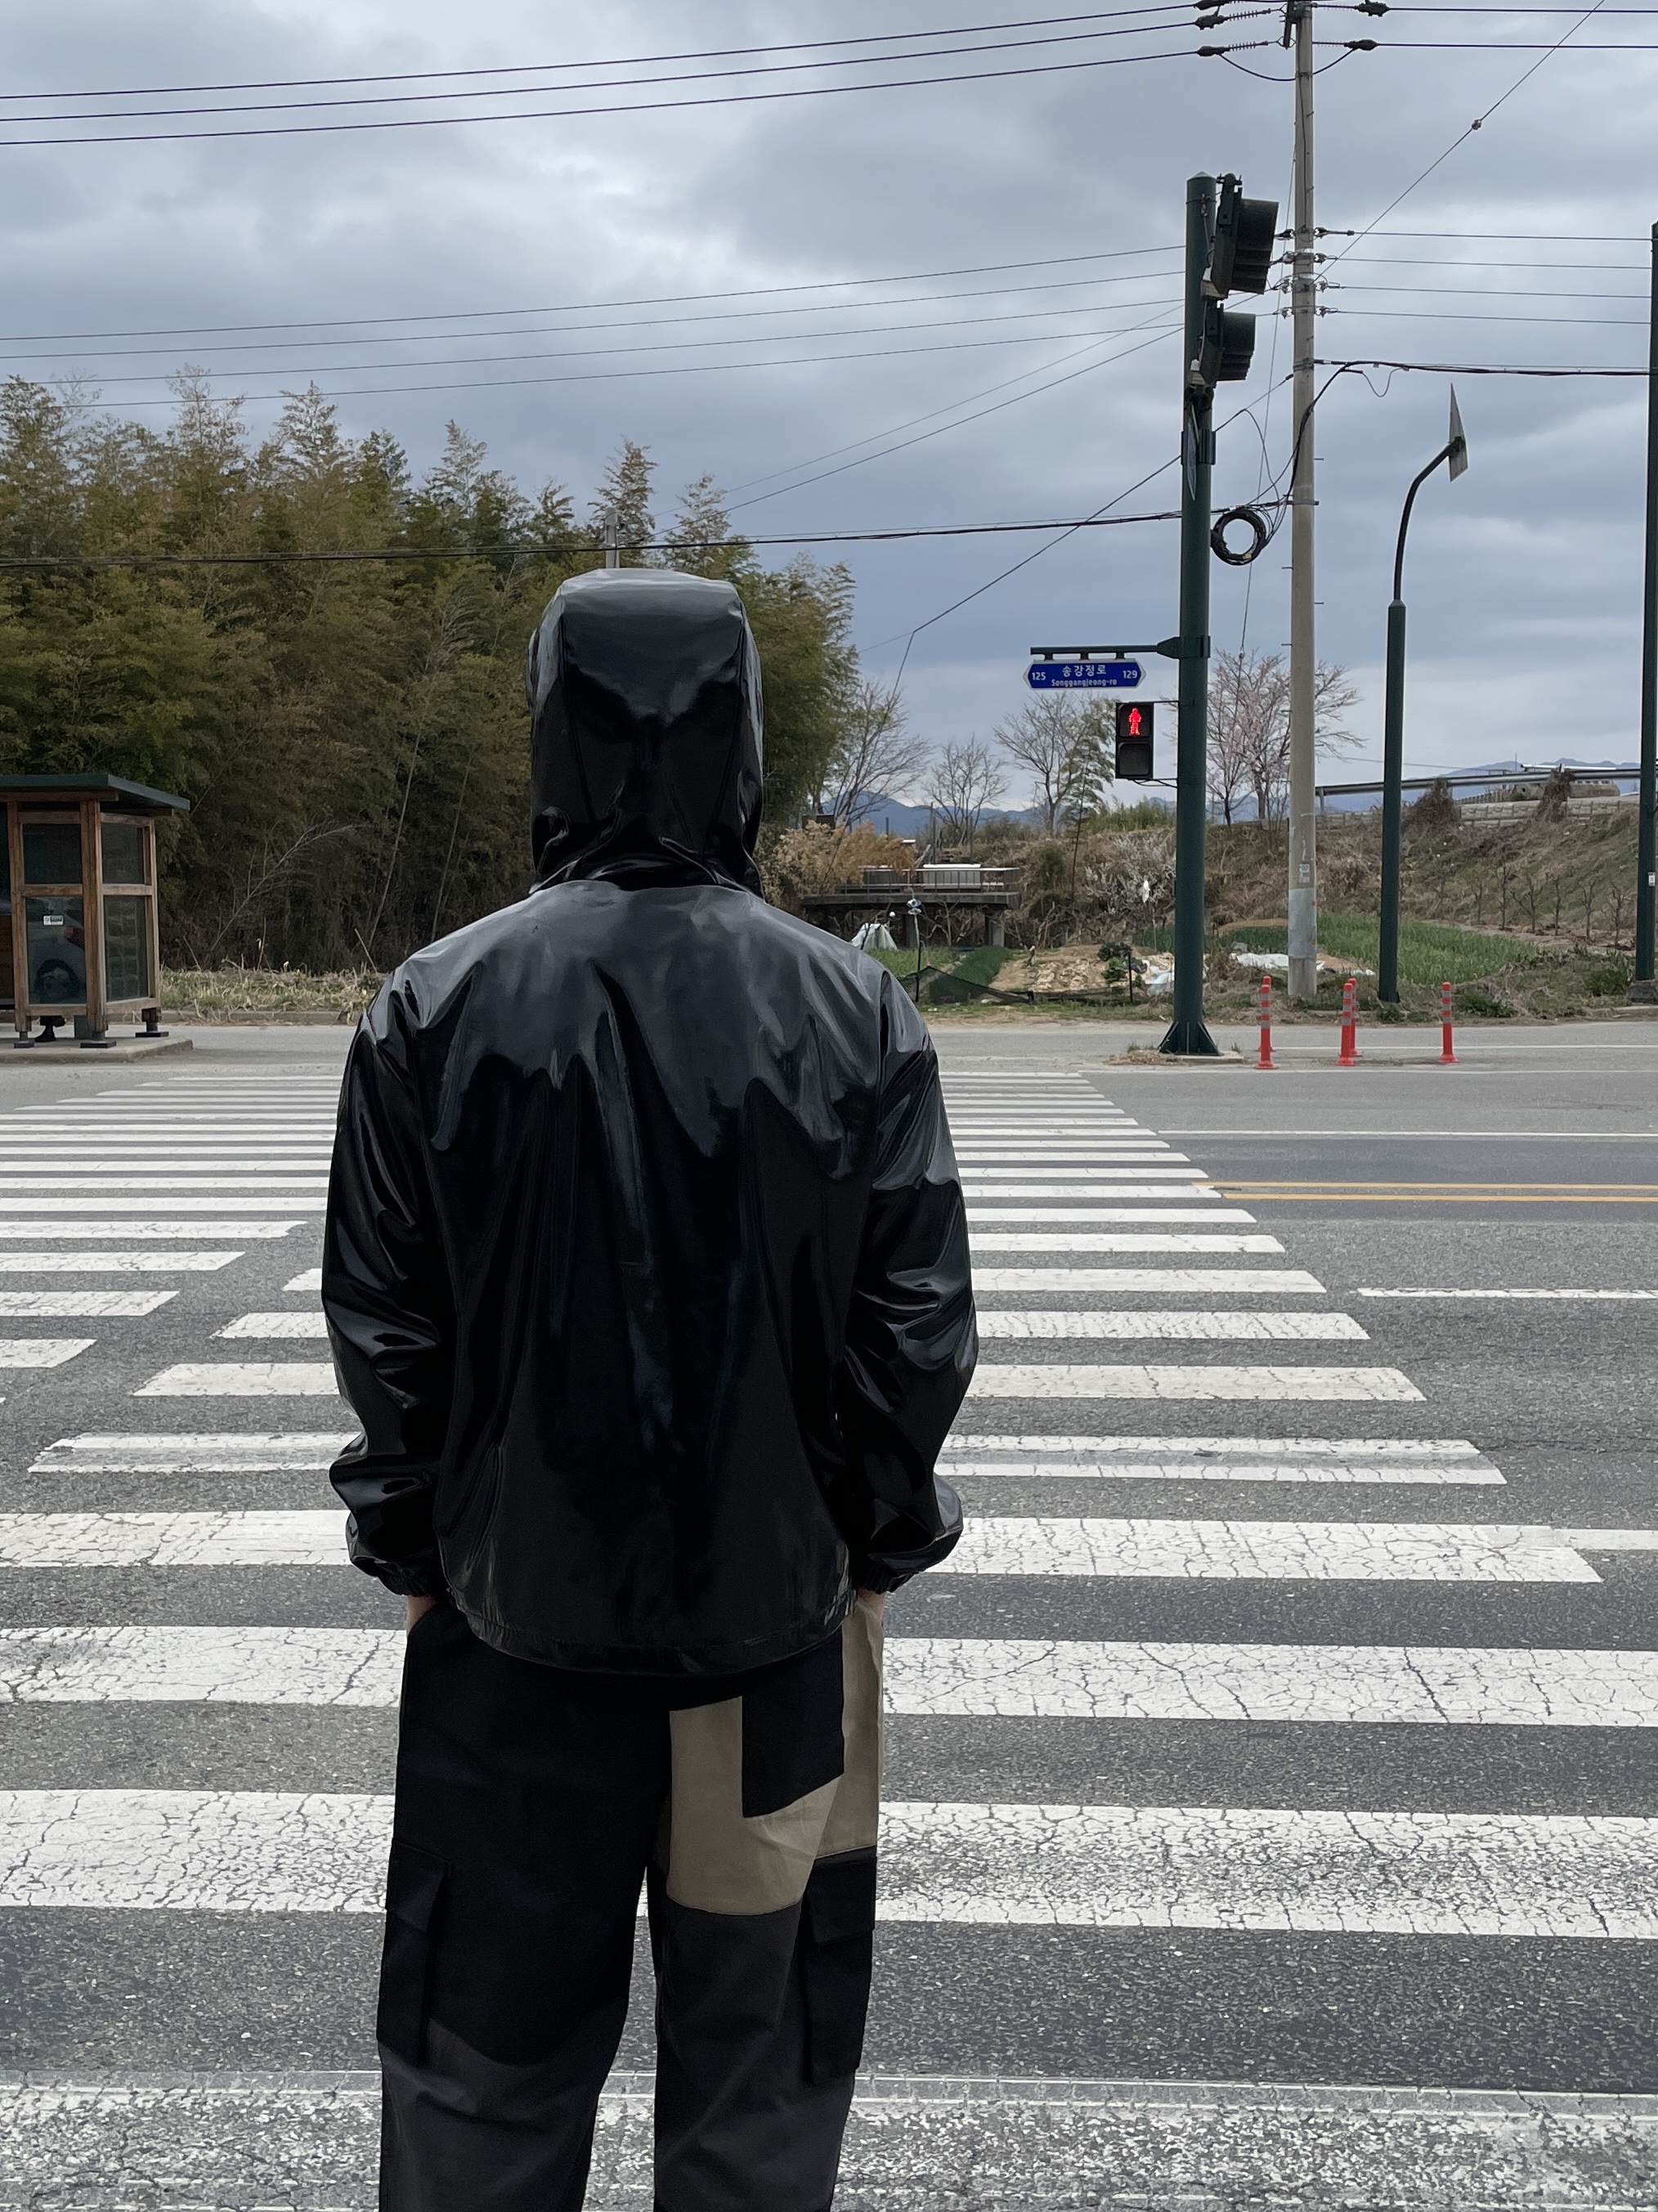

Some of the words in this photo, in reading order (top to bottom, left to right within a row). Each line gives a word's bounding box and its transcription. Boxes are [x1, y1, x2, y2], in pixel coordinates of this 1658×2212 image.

[1062, 665, 1107, 677] 송강정로
[1123, 671, 1138, 679] 129
[1032, 672, 1046, 680] 125
[1051, 679, 1117, 688] Songgangjeong-ro
